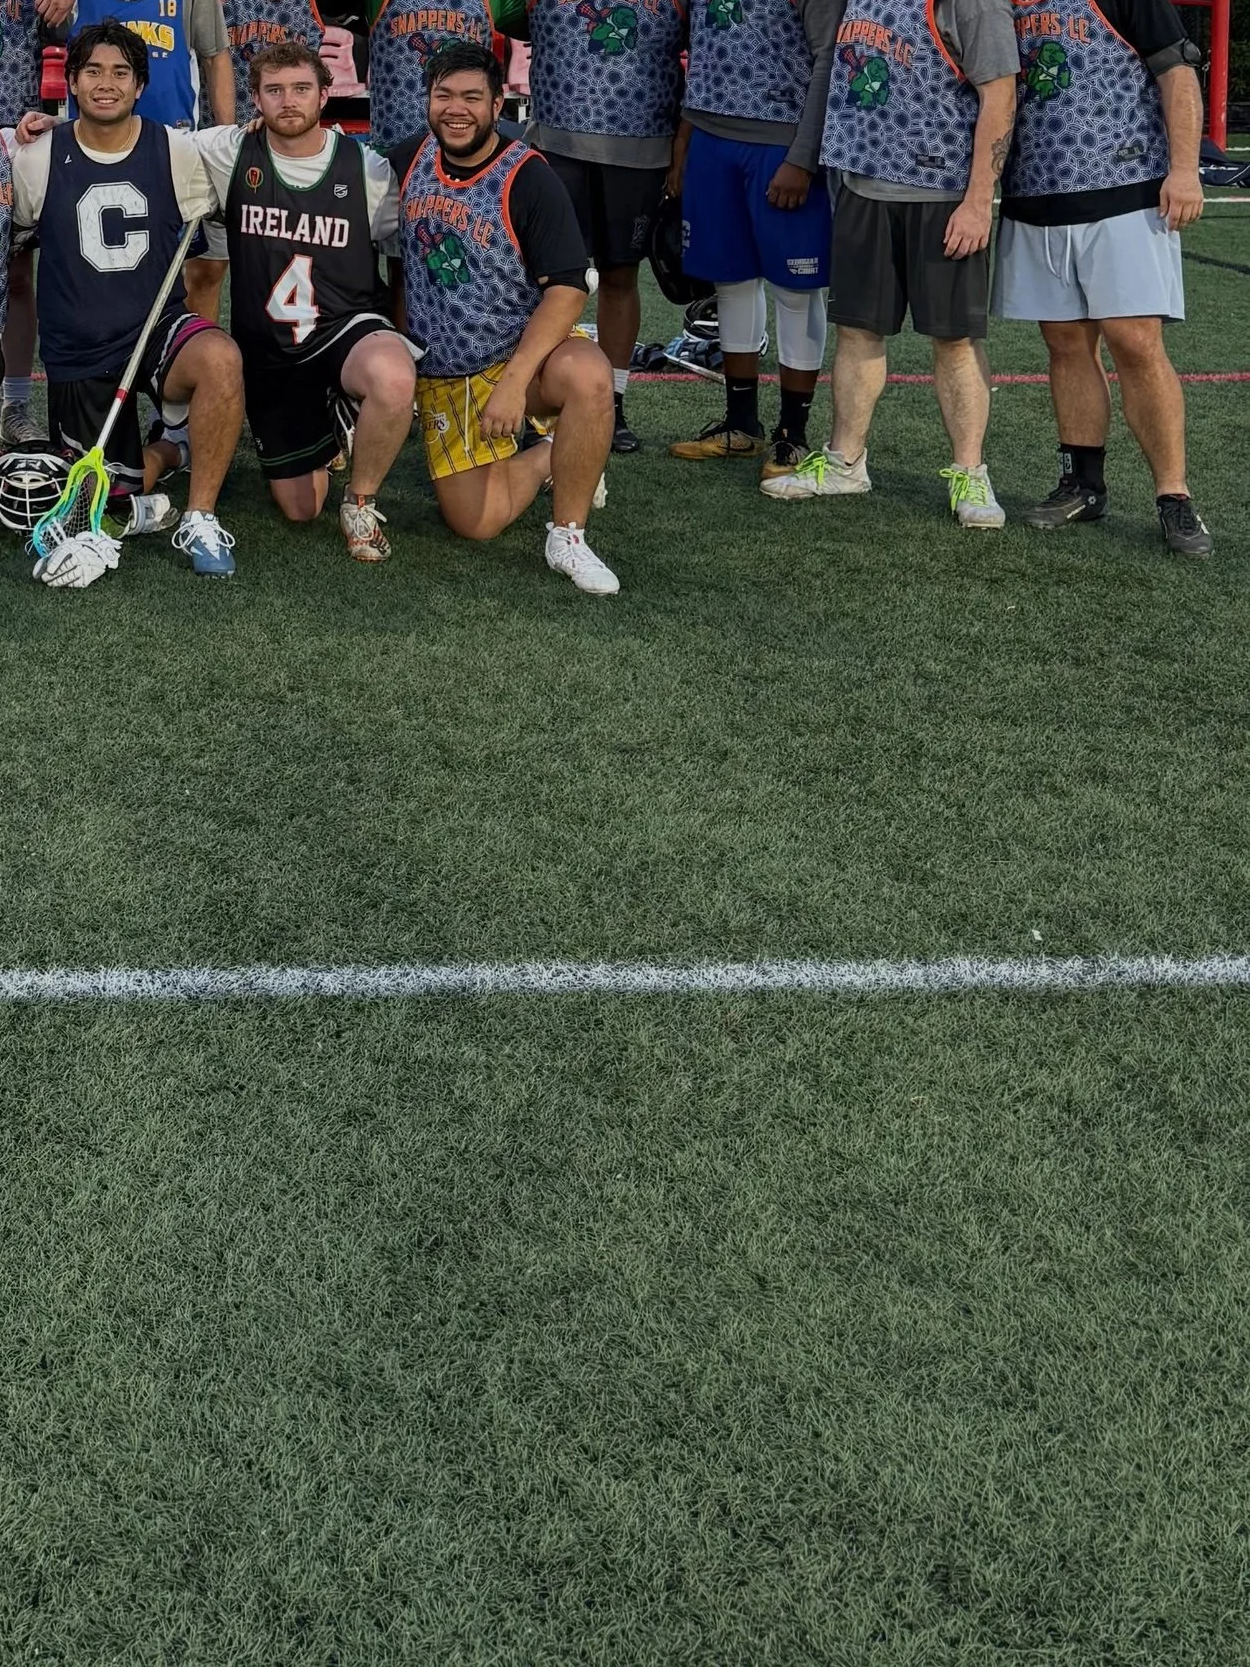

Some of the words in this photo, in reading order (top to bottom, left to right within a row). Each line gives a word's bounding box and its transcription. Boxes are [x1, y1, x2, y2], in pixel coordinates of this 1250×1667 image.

[390, 9, 465, 39] SNAPPERS
[1069, 15, 1091, 43] LC
[895, 37, 914, 67] LC
[76, 181, 150, 272] C
[241, 205, 349, 248] IRELAND
[473, 215, 494, 249] LC
[265, 254, 320, 345] 4
